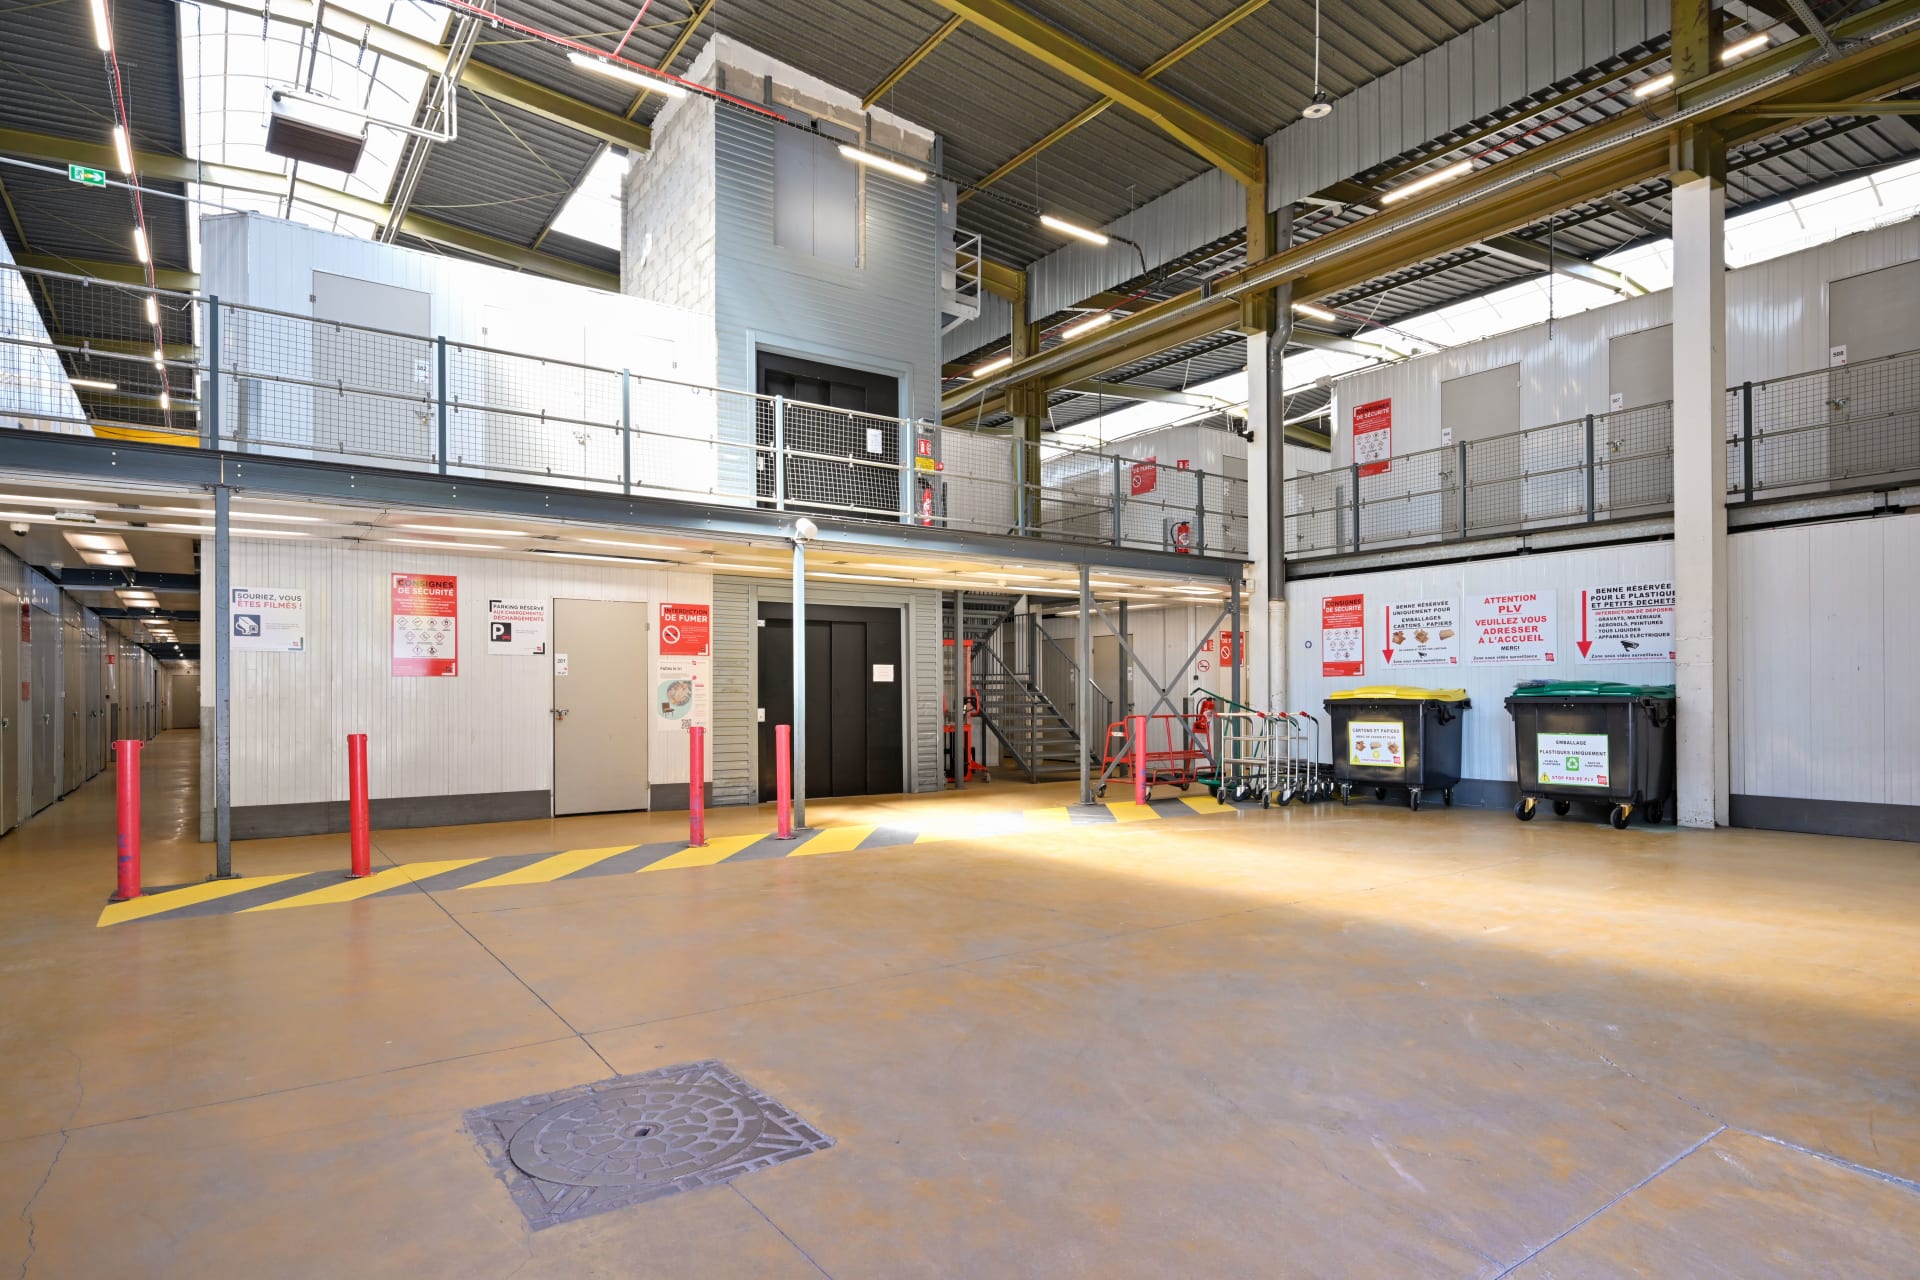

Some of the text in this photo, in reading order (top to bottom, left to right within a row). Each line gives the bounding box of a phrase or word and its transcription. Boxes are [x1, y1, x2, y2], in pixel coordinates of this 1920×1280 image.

[397, 579, 454, 589] CONSIGNES
[412, 586, 454, 596] SÉCURITÉ
[1596, 586, 1624, 594] BENNE
[237, 593, 302, 602] SOURIEZ, VOUS
[1484, 594, 1537, 604] ATTENTION
[237, 599, 261, 608] ÊTES
[263, 600, 297, 609] FILMÉS
[1325, 598, 1362, 607] CONSIGNES
[1604, 600, 1634, 608] PETITS
[1334, 604, 1362, 613] SÉCURITÉ
[1392, 608, 1432, 616] UNIQUEMENT
[1498, 604, 1522, 613] PLV
[664, 614, 708, 623] DE FUMER
[1401, 615, 1441, 623] EMBALLAGES
[1475, 615, 1547, 627] VEUILLEZ VOUS
[492, 623, 505, 640] P
[1483, 626, 1539, 635] ADRESSER
[1478, 634, 1544, 644] À L'ACCUEIL
